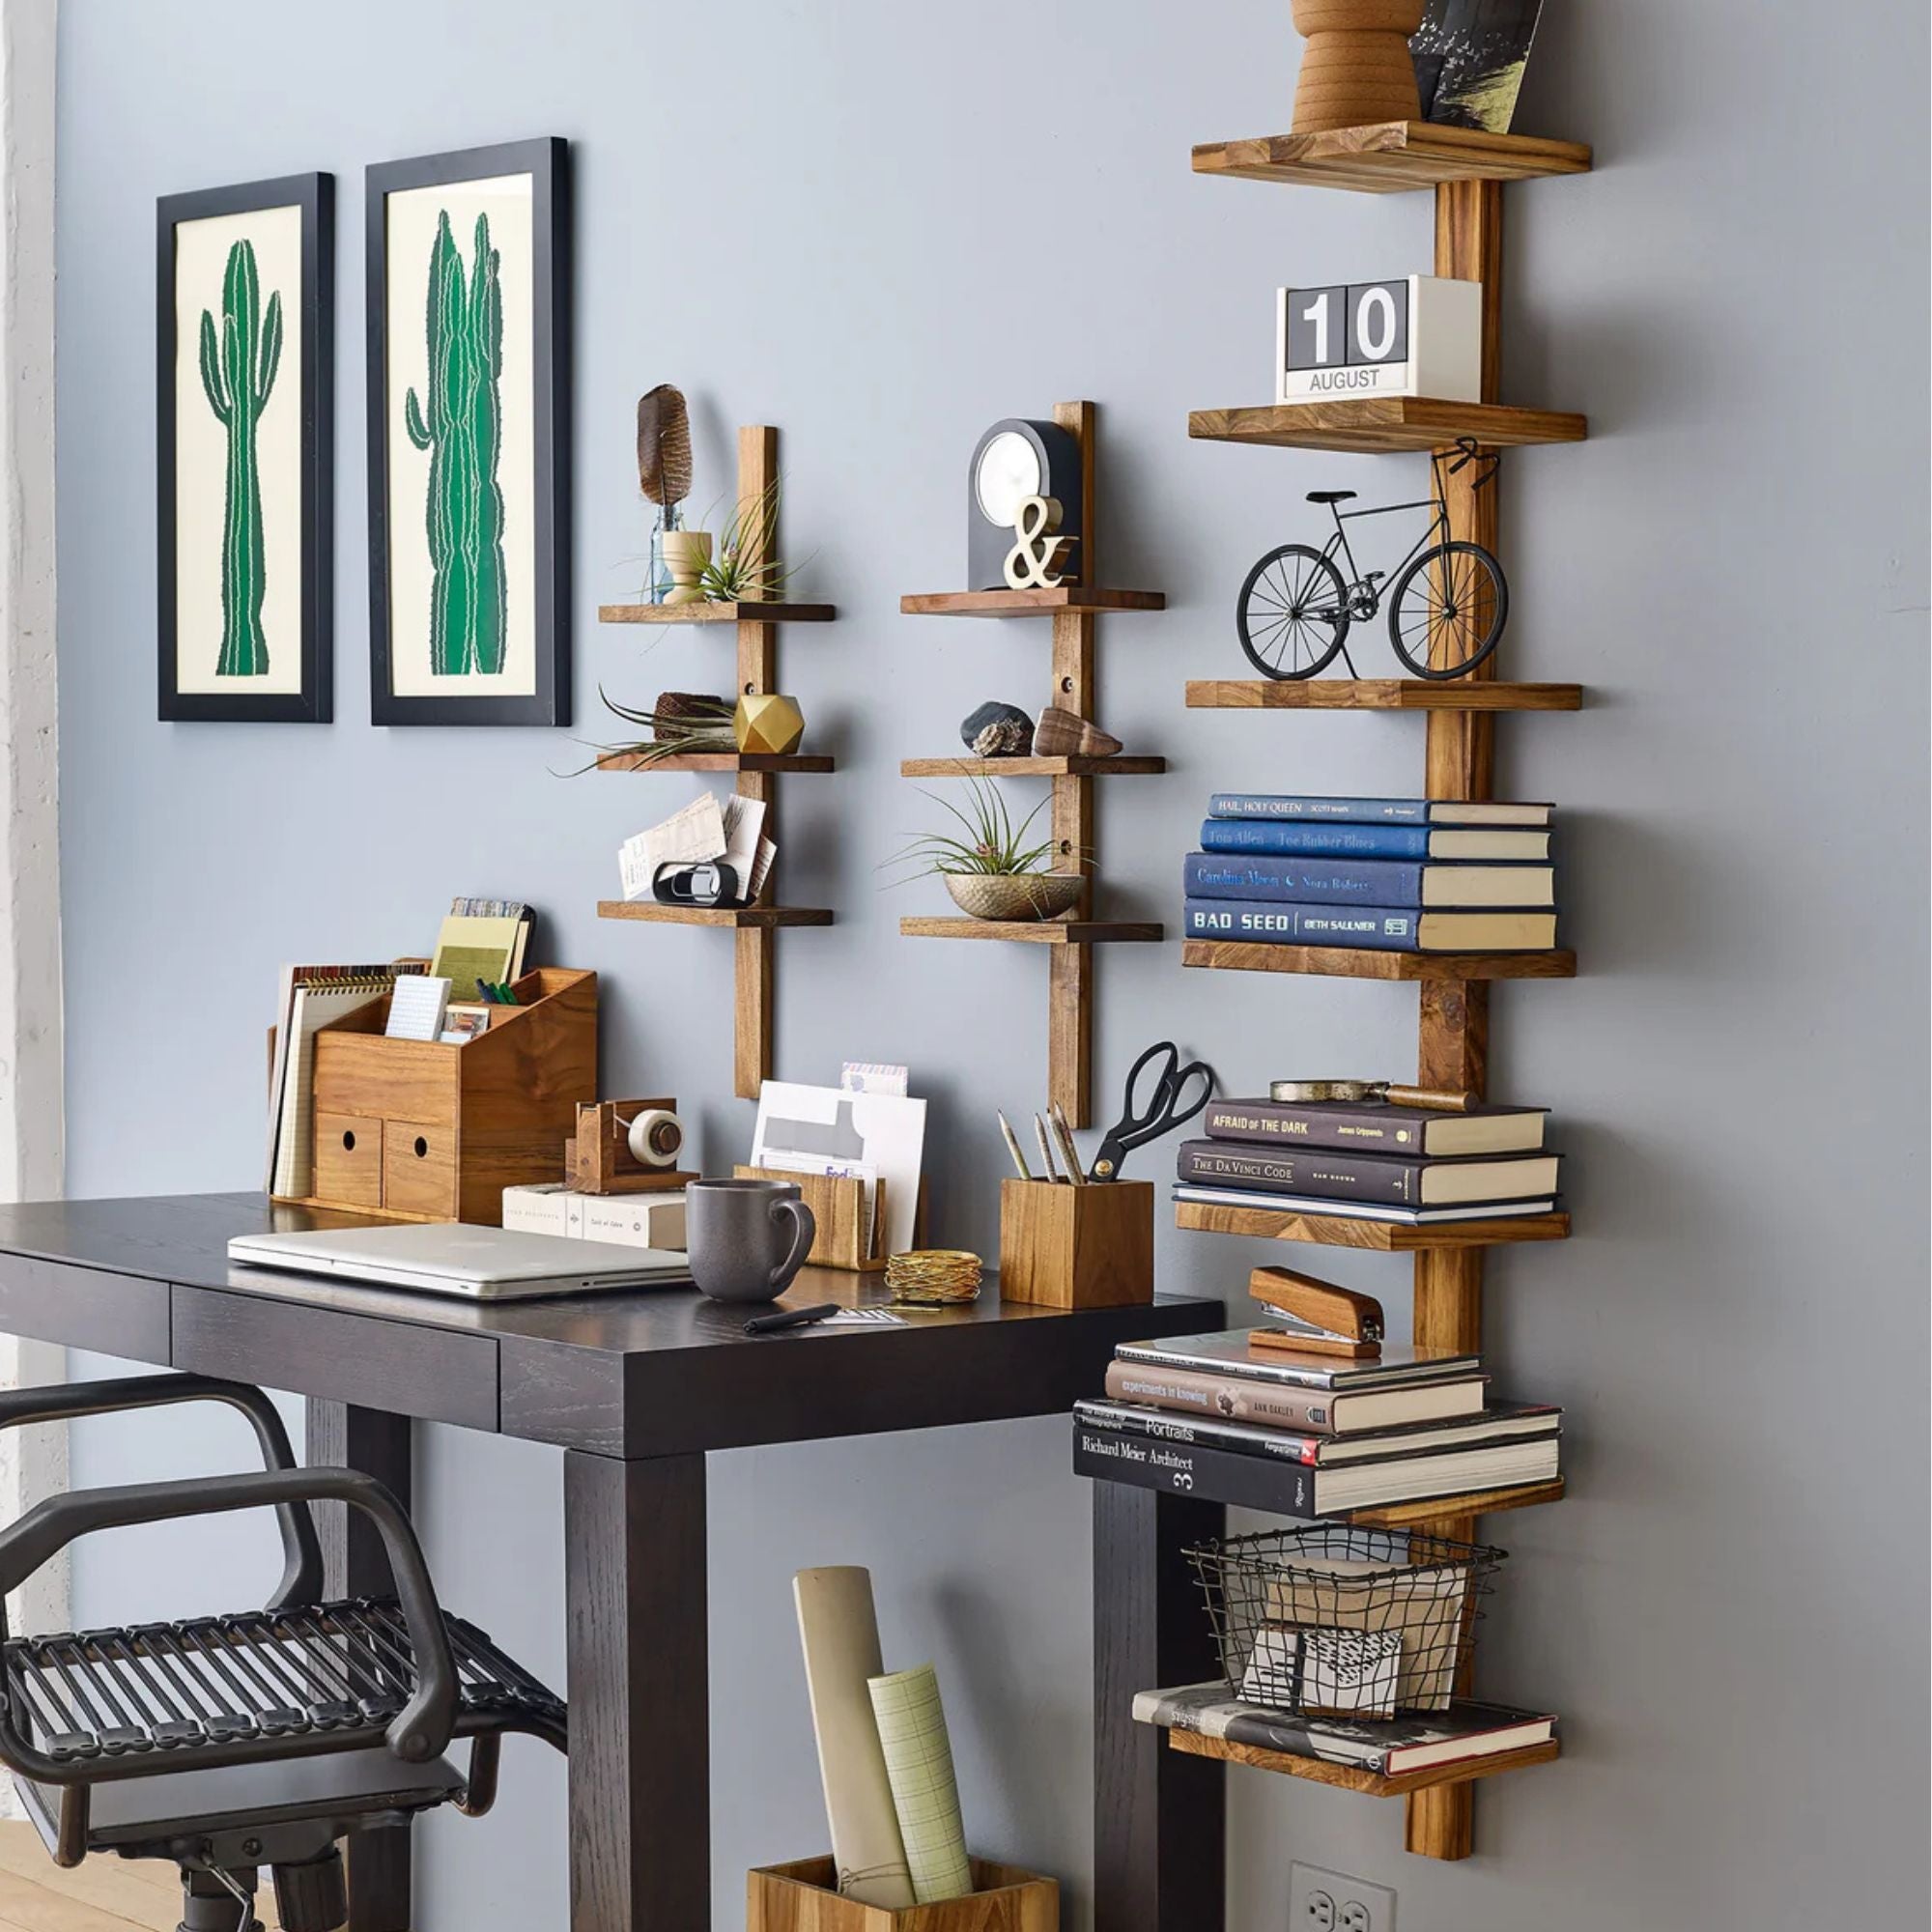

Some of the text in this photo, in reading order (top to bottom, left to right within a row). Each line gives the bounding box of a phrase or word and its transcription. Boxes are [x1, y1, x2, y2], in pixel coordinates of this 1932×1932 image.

[1304, 287, 1396, 363] 10
[1310, 369, 1379, 390] AUGUST
[1244, 802, 1268, 812] HOLY
[1269, 803, 1302, 814] QUEEN
[1344, 834, 1376, 849] Blues
[1194, 912, 1290, 931] BAD SEED
[1304, 919, 1329, 930] BETH
[1213, 1115, 1248, 1129] AFRAID
[1261, 1119, 1280, 1132] THE
[1281, 1121, 1309, 1134] DARK
[1122, 1380, 1167, 1398] experiments
[1177, 1387, 1208, 1406] knowing
[1146, 1418, 1195, 1442] Portraits
[1082, 1435, 1194, 1470] Richard Meier Architect
[1173, 1473, 1193, 1491] 3
